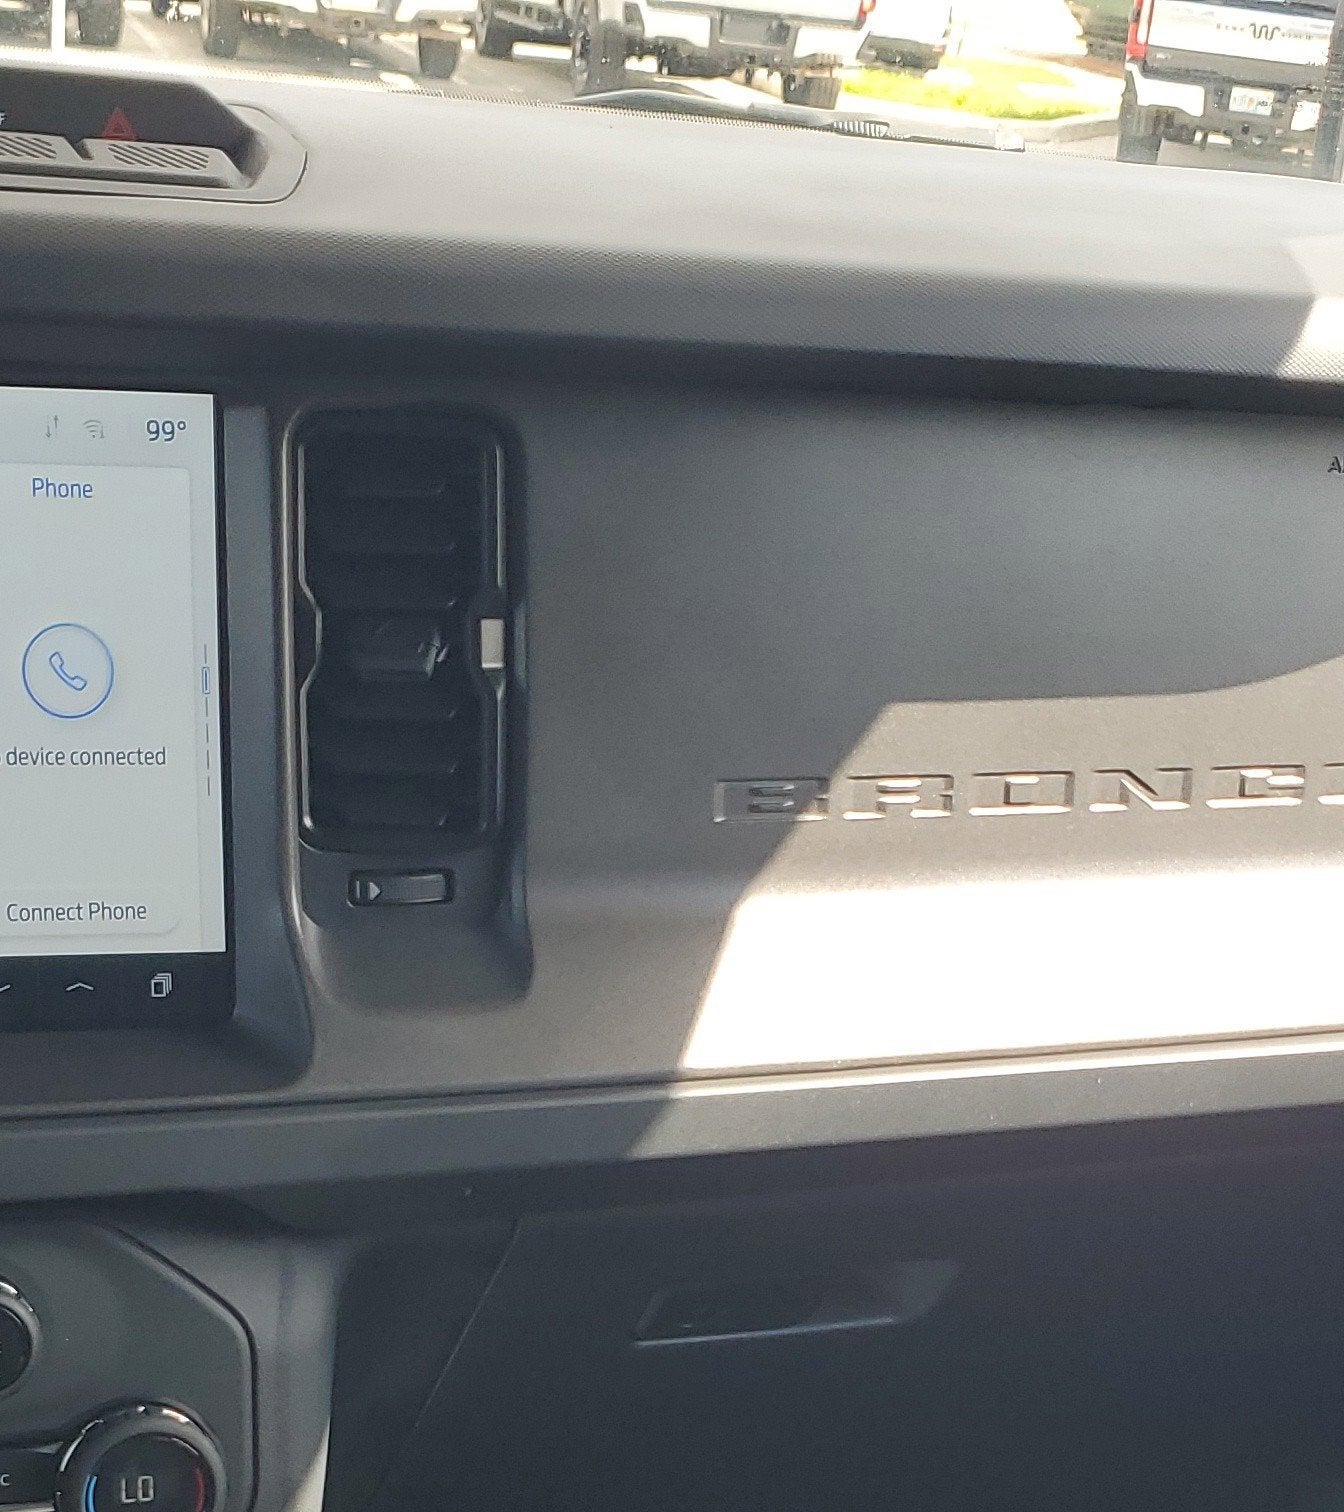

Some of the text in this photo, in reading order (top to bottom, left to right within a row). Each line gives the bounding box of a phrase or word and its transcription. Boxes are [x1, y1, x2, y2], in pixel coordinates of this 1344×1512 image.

[31, 477, 93, 500] Phone
[6, 745, 65, 766] device
[70, 745, 166, 767] connected
[7, 901, 147, 922] Connect Phone
[121, 1475, 154, 1503] LO
